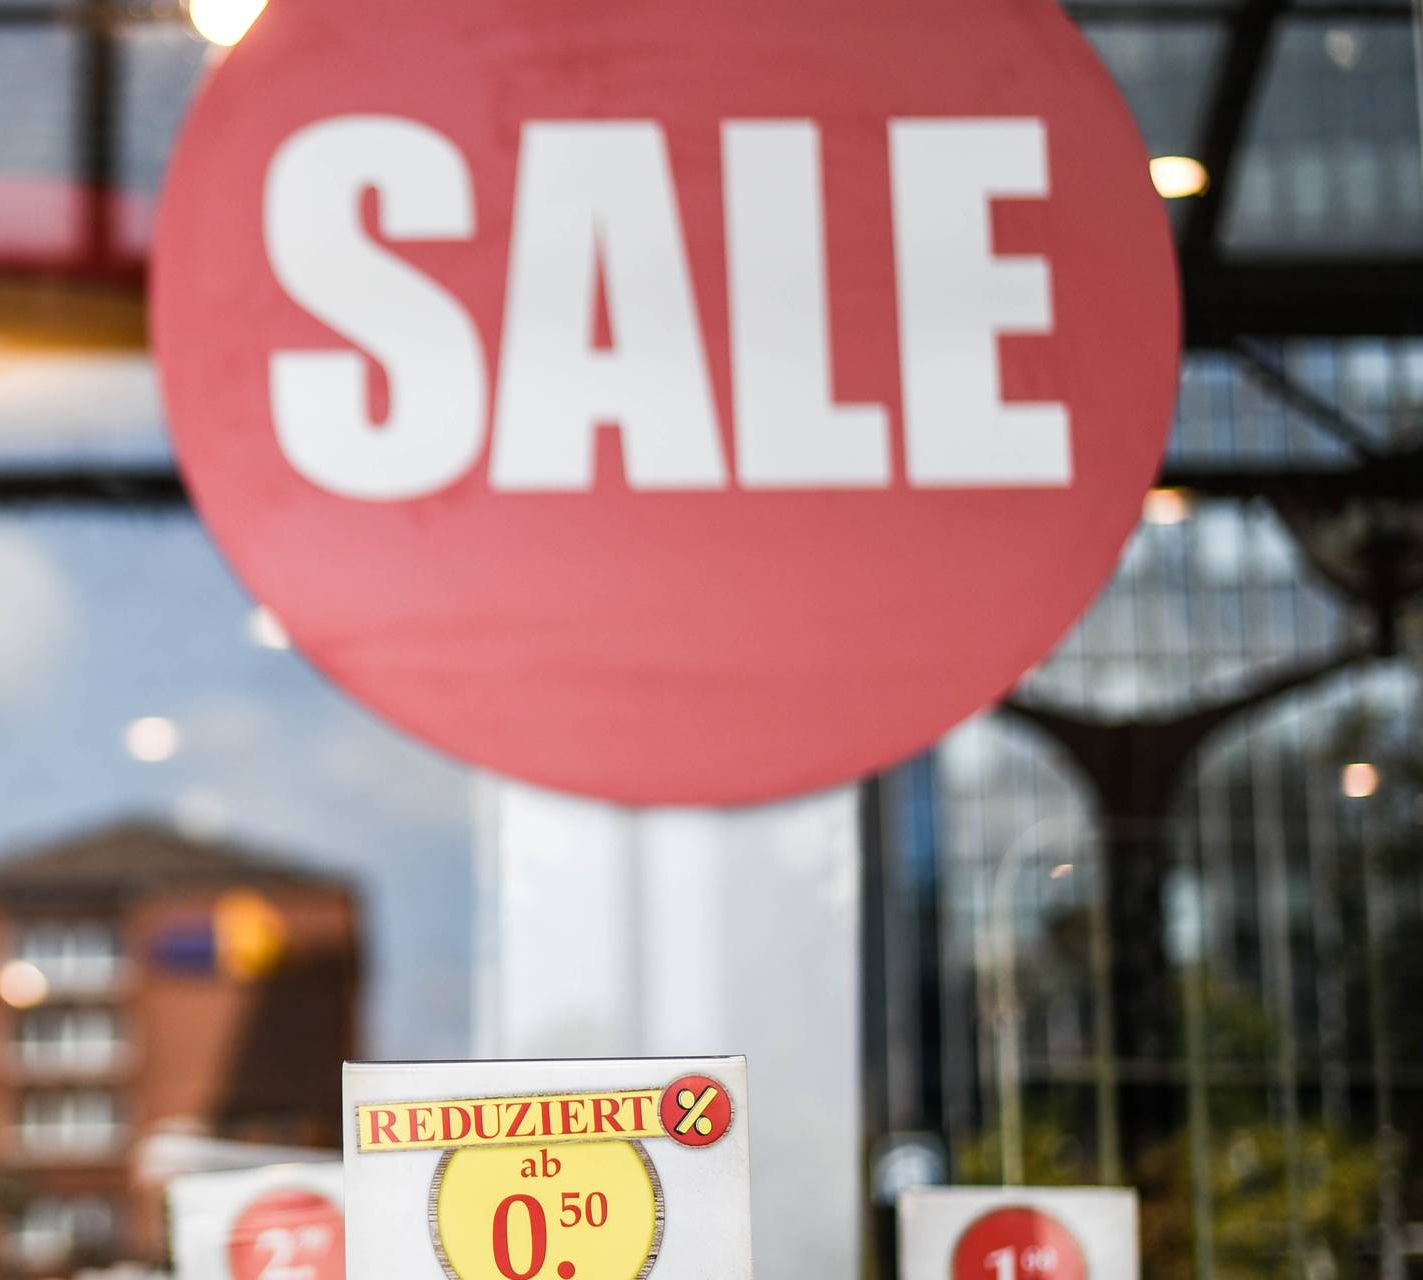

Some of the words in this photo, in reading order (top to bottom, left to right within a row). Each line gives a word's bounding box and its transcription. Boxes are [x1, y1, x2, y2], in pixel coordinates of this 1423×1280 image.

[263, 114, 1072, 500] SALE
[368, 1096, 653, 1144] REDUZIERT
[520, 1148, 562, 1178] ab
